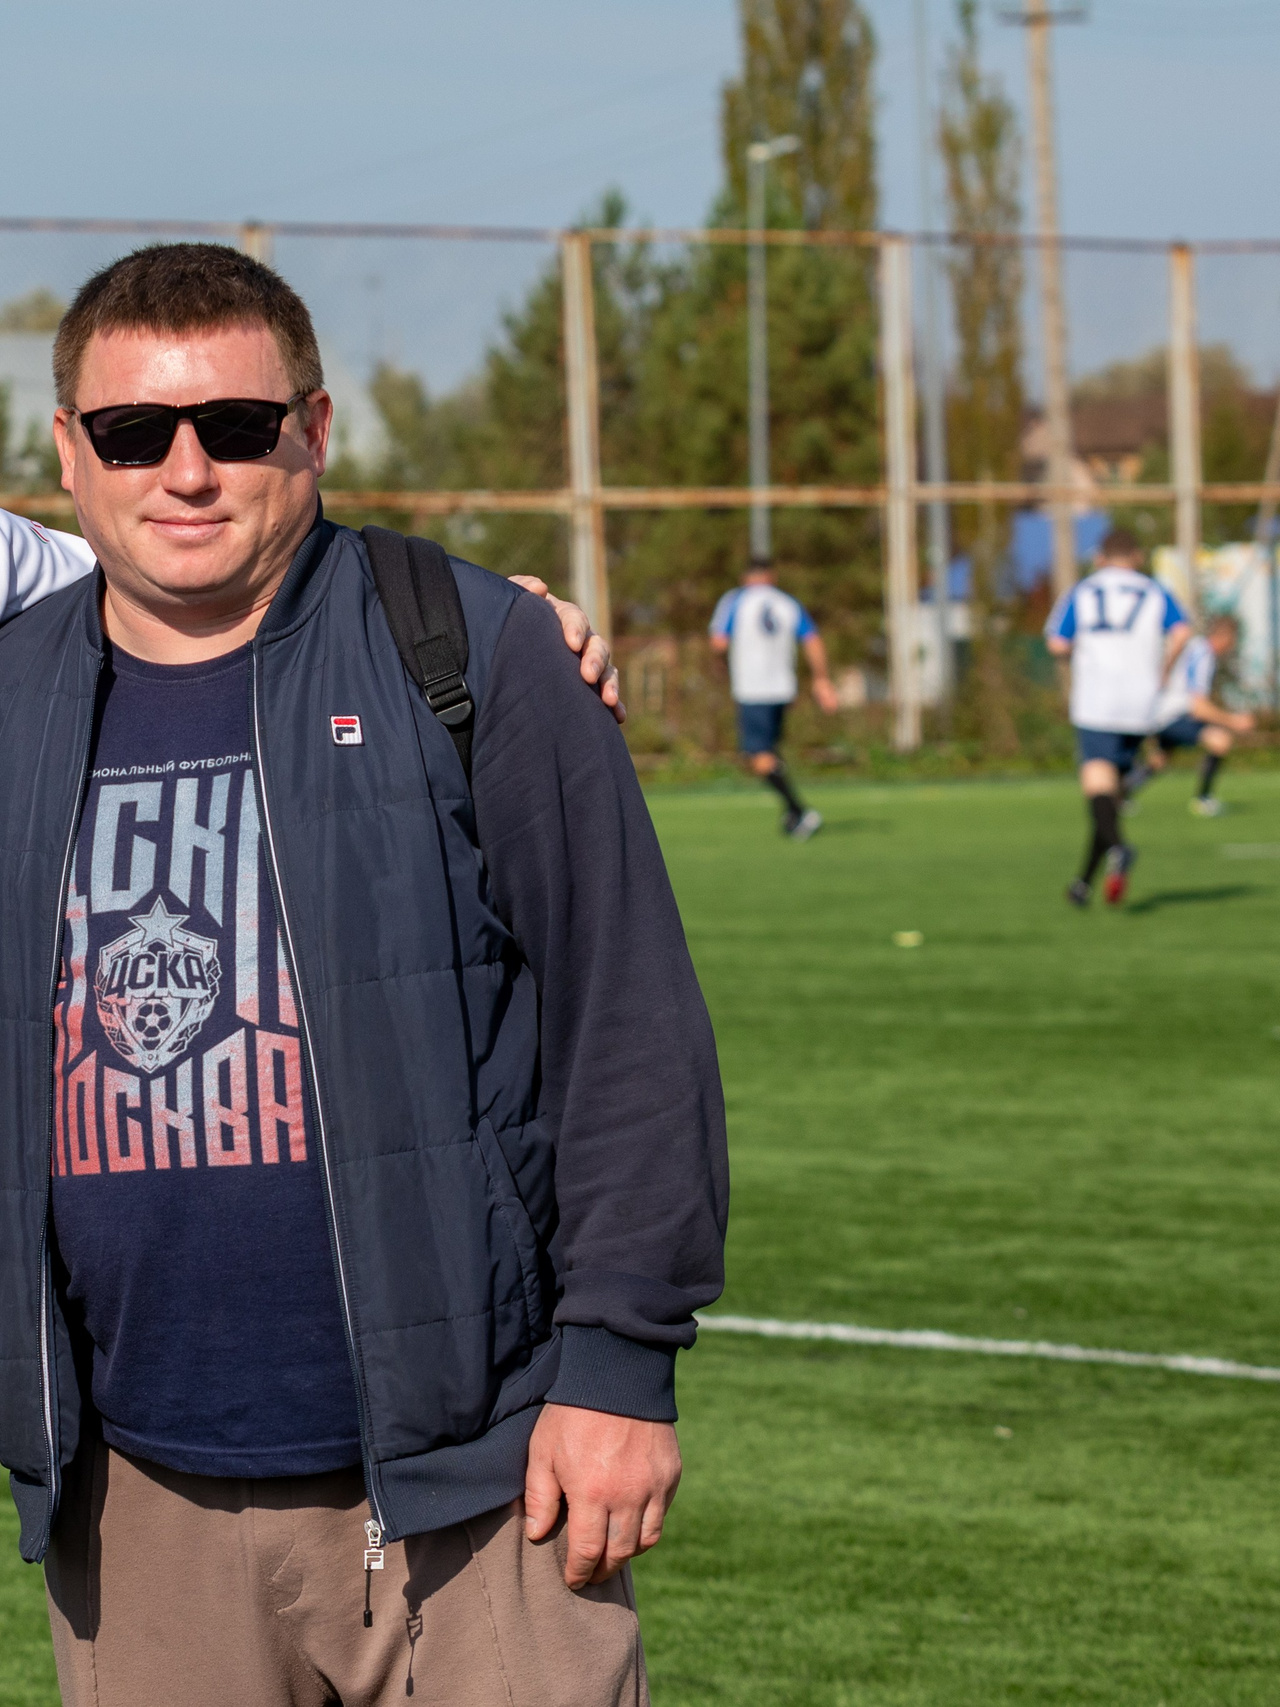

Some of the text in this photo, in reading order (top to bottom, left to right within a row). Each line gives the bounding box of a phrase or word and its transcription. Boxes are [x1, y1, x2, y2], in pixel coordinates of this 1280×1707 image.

[1088, 586, 1147, 632] 17
[179, 752, 251, 770] ФУТБОЛЬН
[104, 952, 209, 997] ЦСКА
[51, 1003, 308, 1177] ОСКВА
